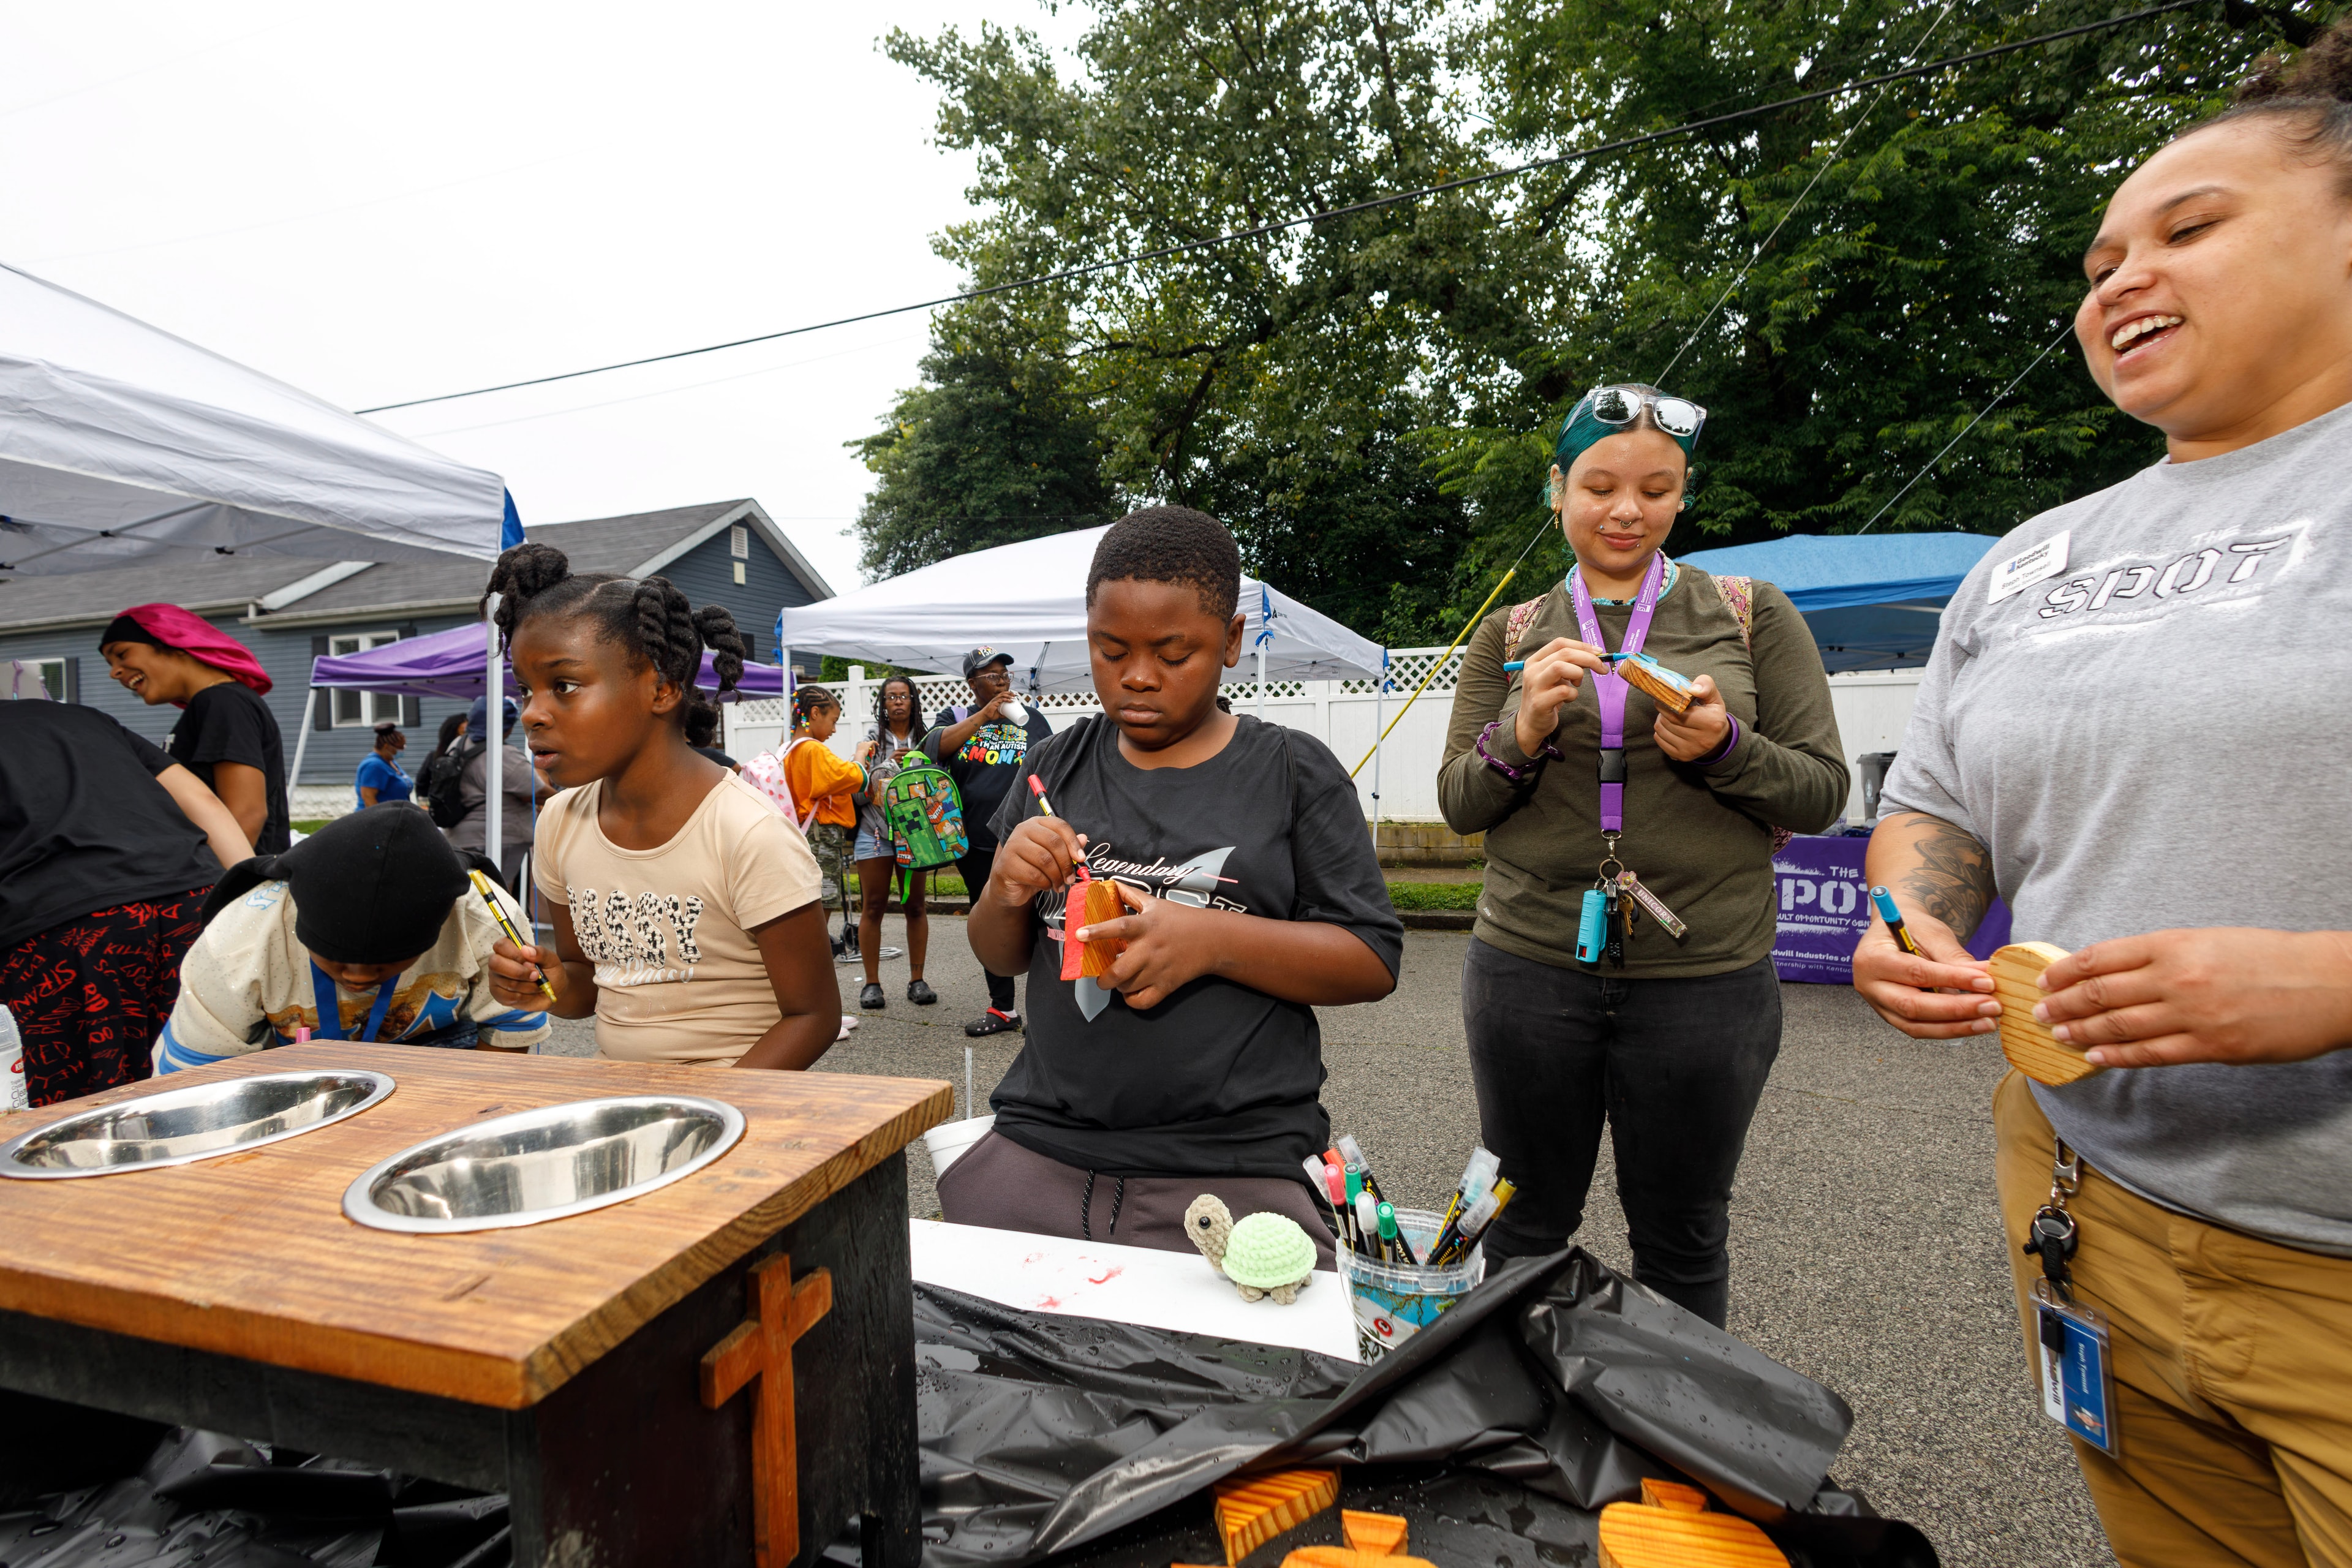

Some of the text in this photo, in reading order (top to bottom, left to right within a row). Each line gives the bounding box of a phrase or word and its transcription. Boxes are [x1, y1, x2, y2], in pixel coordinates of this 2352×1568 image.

[2191, 524, 2242, 546] THE
[2016, 543, 2050, 565] Goodwill
[2016, 551, 2049, 570] Kentucky
[2038, 535, 2292, 619] SPOT
[1640, 589, 1648, 603] Goodwill
[979, 741, 990, 749] I'M
[1001, 742, 1027, 751] AUTISM
[968, 745, 1016, 765] MOM
[1830, 865, 1858, 878] THE
[1637, 889, 1673, 923] UNICORN
[1795, 914, 1851, 925] OPPORTUNITY
[1795, 951, 1839, 962] Industries
[11, 1089, 27, 1099] Clea
